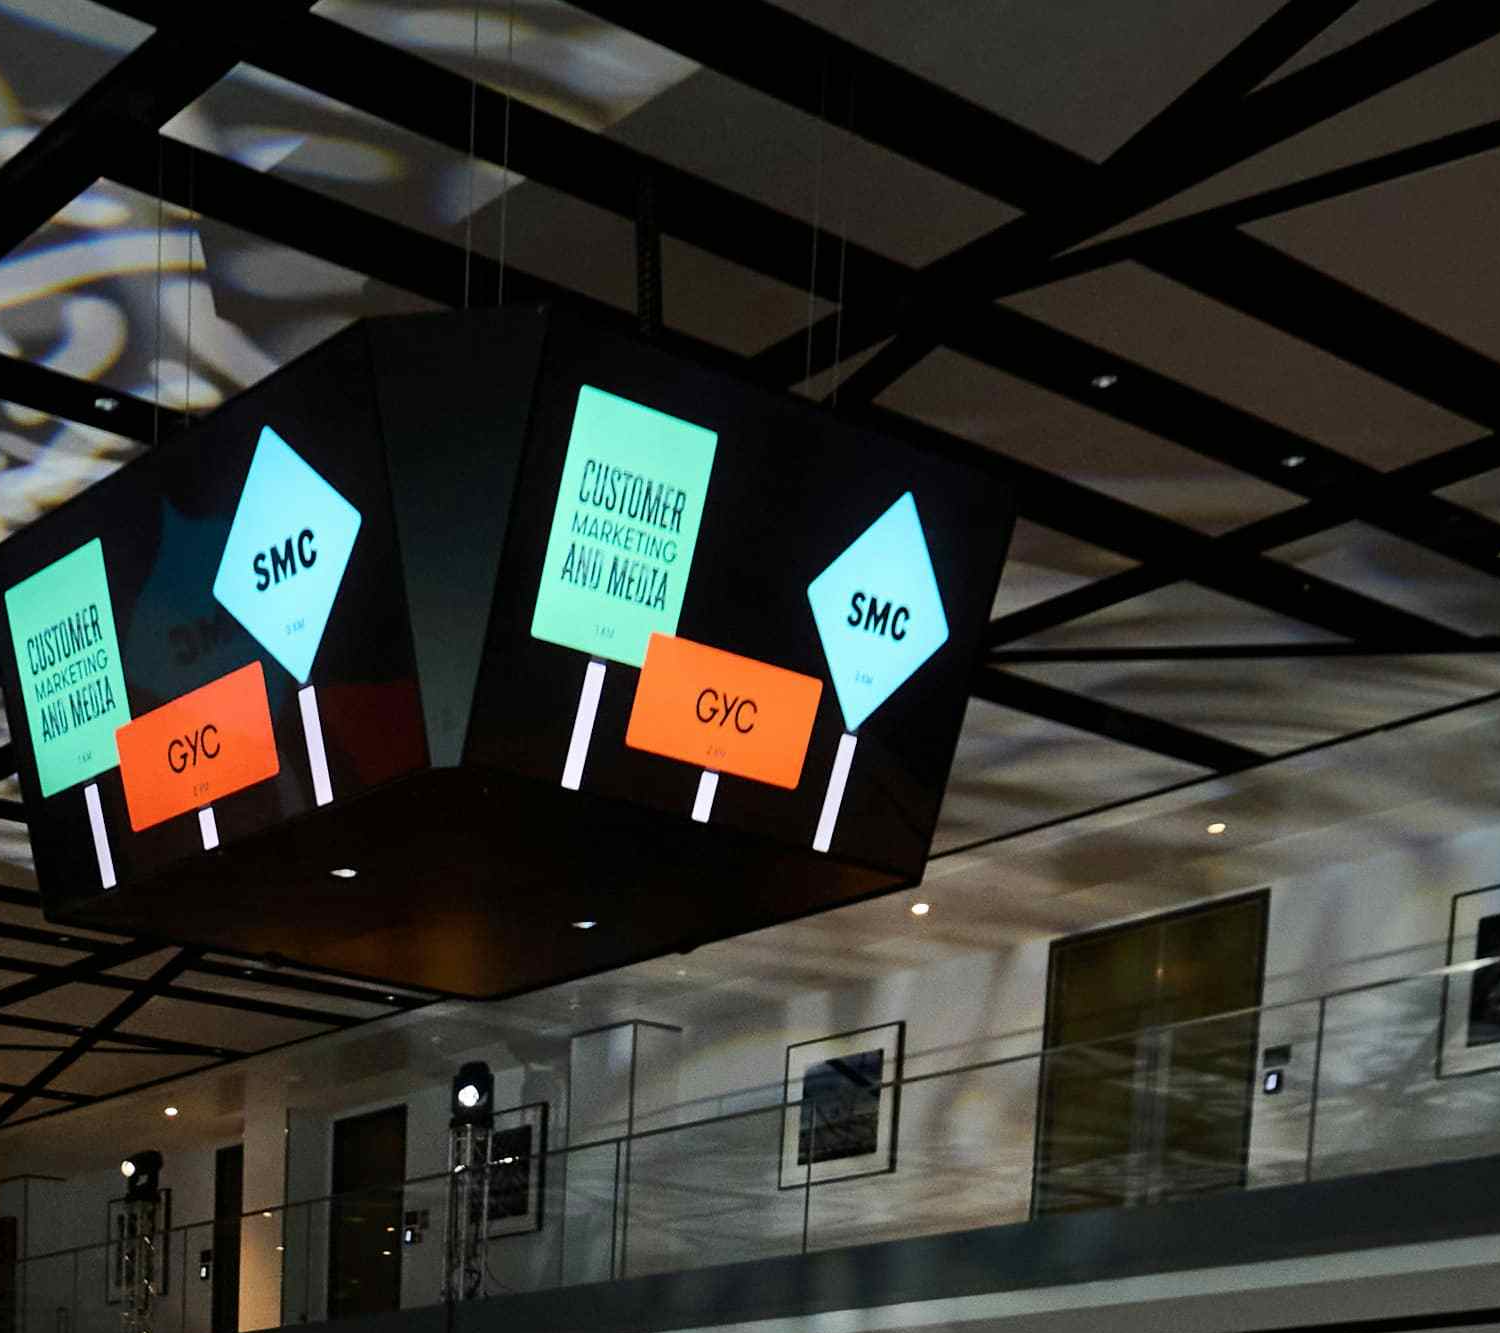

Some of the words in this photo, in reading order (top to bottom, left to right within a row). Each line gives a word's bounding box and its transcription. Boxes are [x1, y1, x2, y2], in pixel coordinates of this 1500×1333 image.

[578, 459, 687, 535] CUSTOMER
[252, 528, 318, 592] SMC
[570, 511, 679, 564] MARKETING
[560, 542, 603, 591] AND
[606, 556, 670, 611] MEDIA
[26, 604, 103, 675] CUSTOMER
[847, 591, 911, 641] SMC
[34, 649, 109, 704] MARKETING
[41, 698, 69, 743] AND
[69, 675, 117, 729] MEDIA
[696, 688, 758, 734] GYC
[167, 724, 221, 774] GYC
